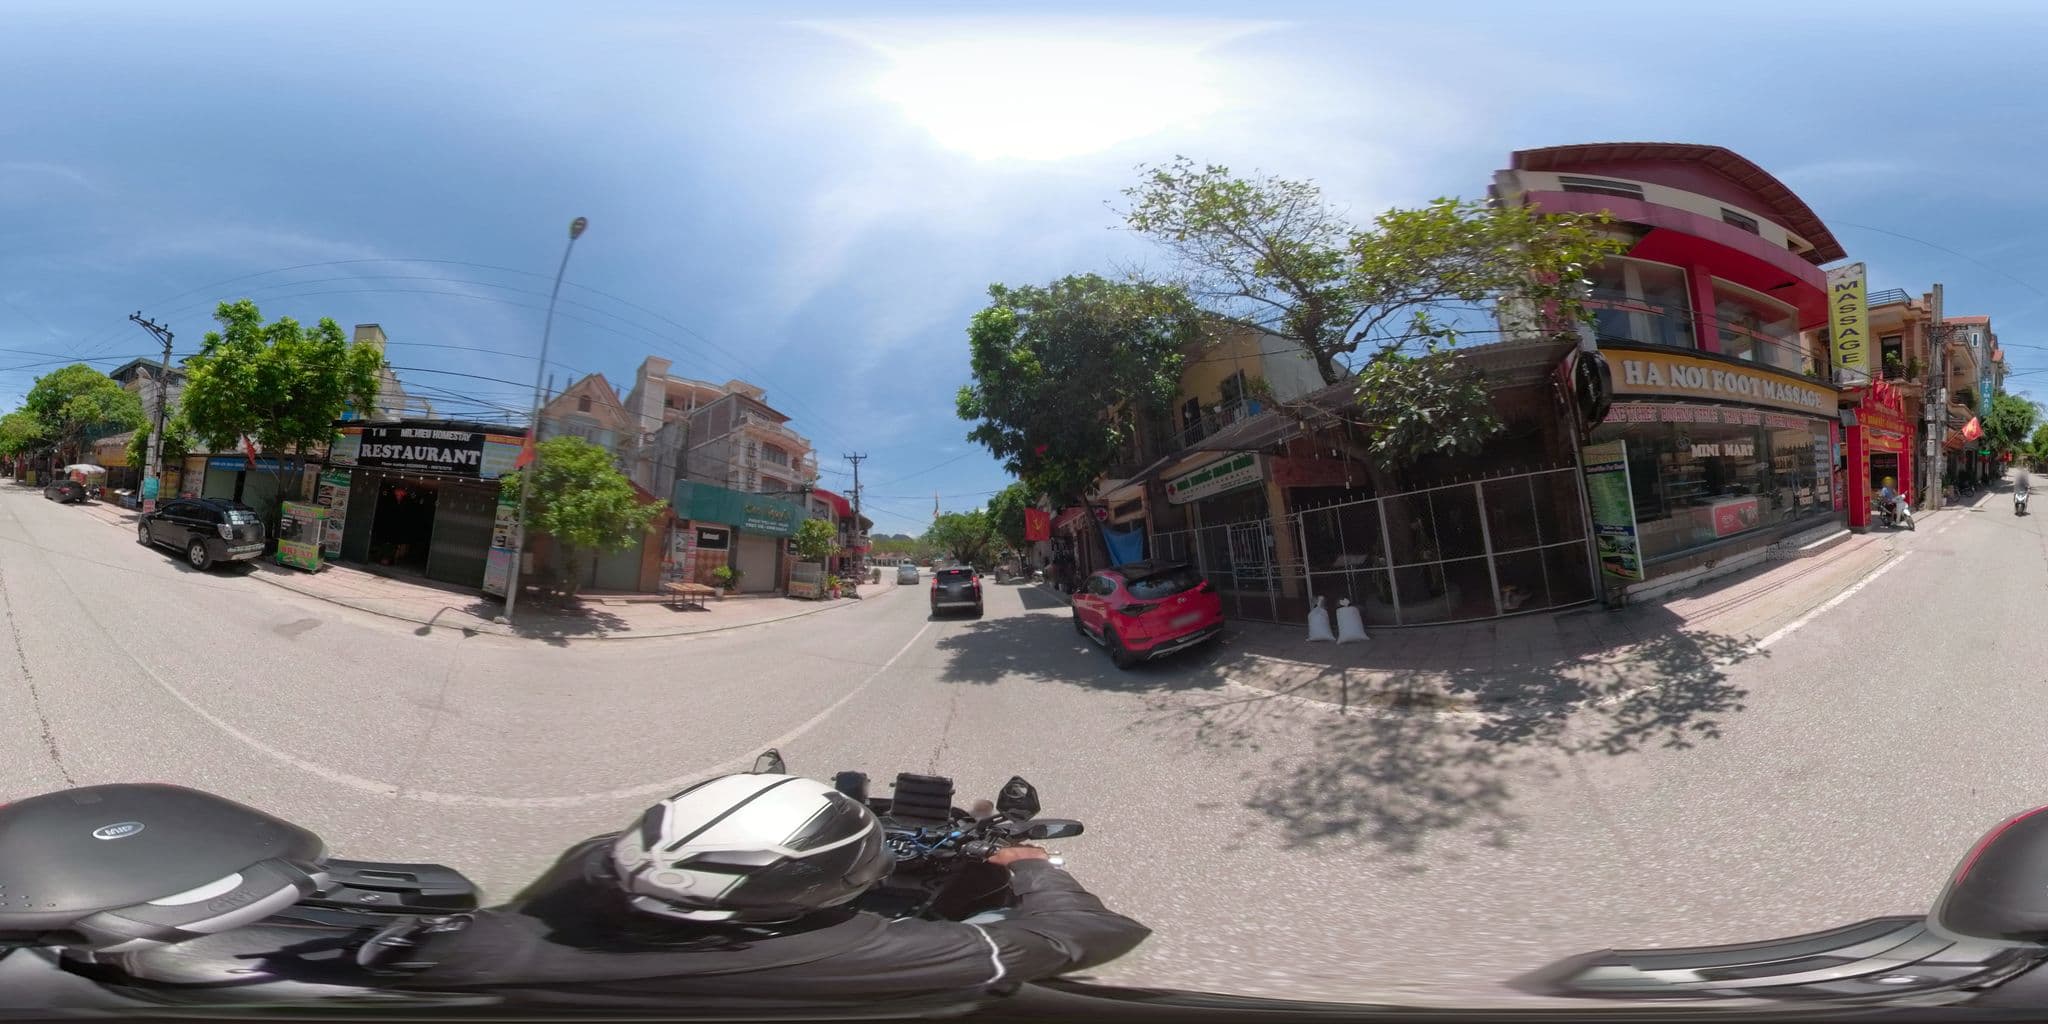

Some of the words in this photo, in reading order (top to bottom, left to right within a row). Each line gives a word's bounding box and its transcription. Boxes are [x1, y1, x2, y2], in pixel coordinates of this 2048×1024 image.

[1835, 280, 1860, 363] MASSAGE
[1622, 360, 1663, 386] HA
[1669, 362, 1710, 389] NOI
[1711, 369, 1761, 397] FOOT
[1762, 380, 1823, 408] MASSAGE
[361, 443, 481, 465] RESTAURANT
[1690, 444, 1720, 458] MINI
[1724, 444, 1754, 457] MART
